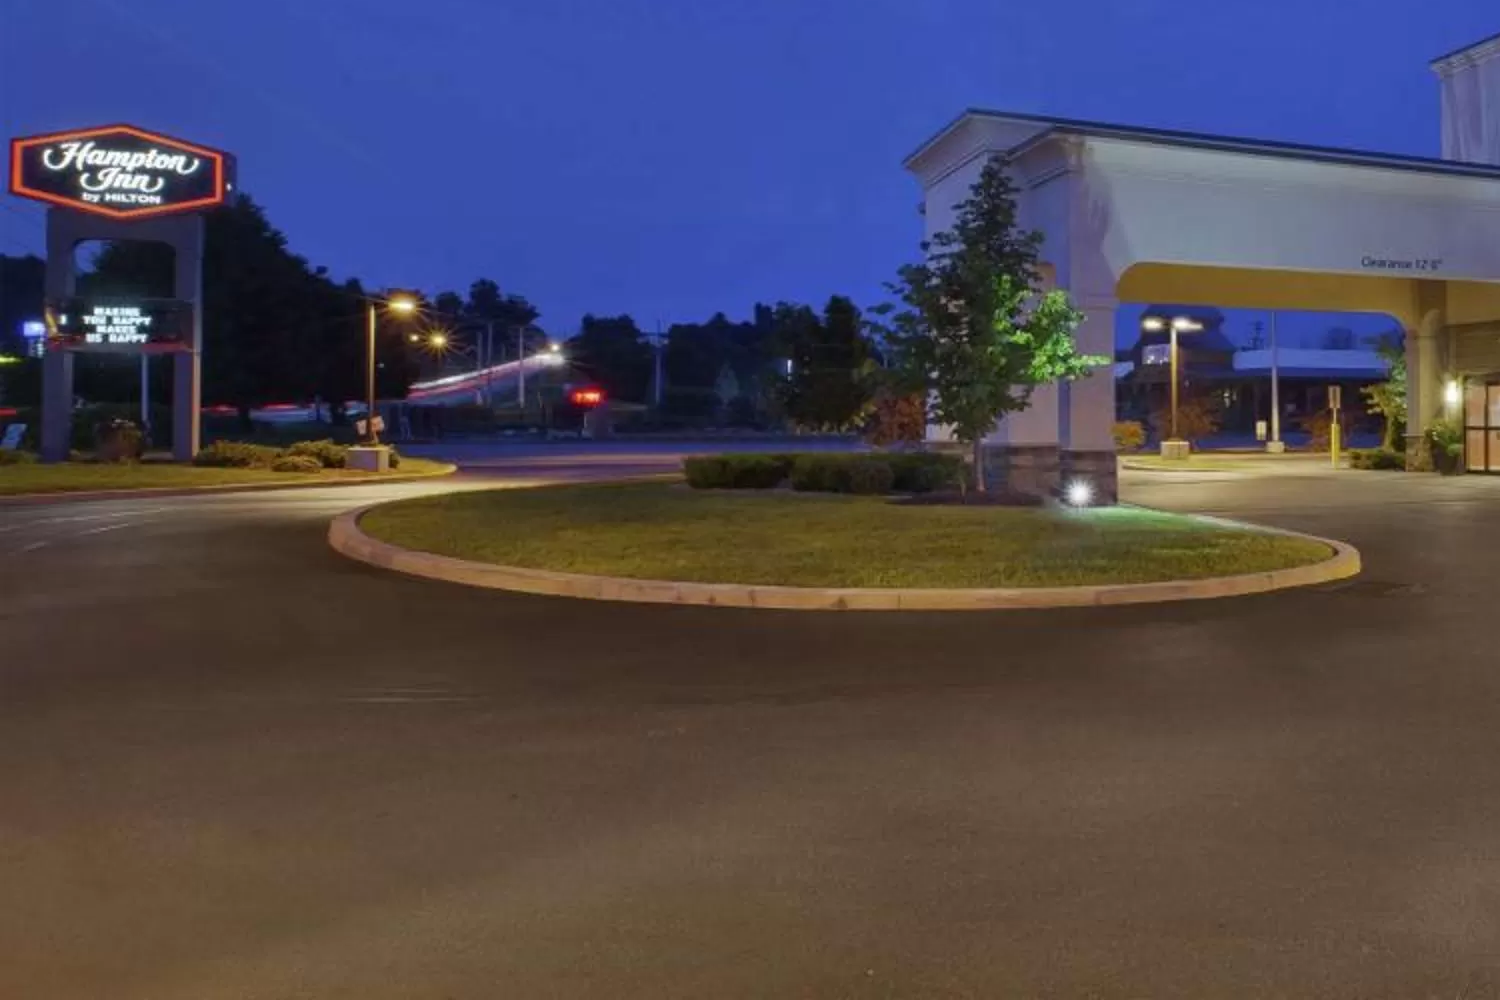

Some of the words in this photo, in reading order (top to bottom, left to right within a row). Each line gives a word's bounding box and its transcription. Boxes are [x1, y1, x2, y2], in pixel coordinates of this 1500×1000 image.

[43, 141, 199, 175] Hampton
[80, 167, 164, 192] Inn
[82, 192, 101, 204] by
[104, 193, 162, 204] HILTON
[113, 316, 152, 325] HAPPY
[85, 334, 103, 343] US
[109, 334, 148, 343] HAPPY
